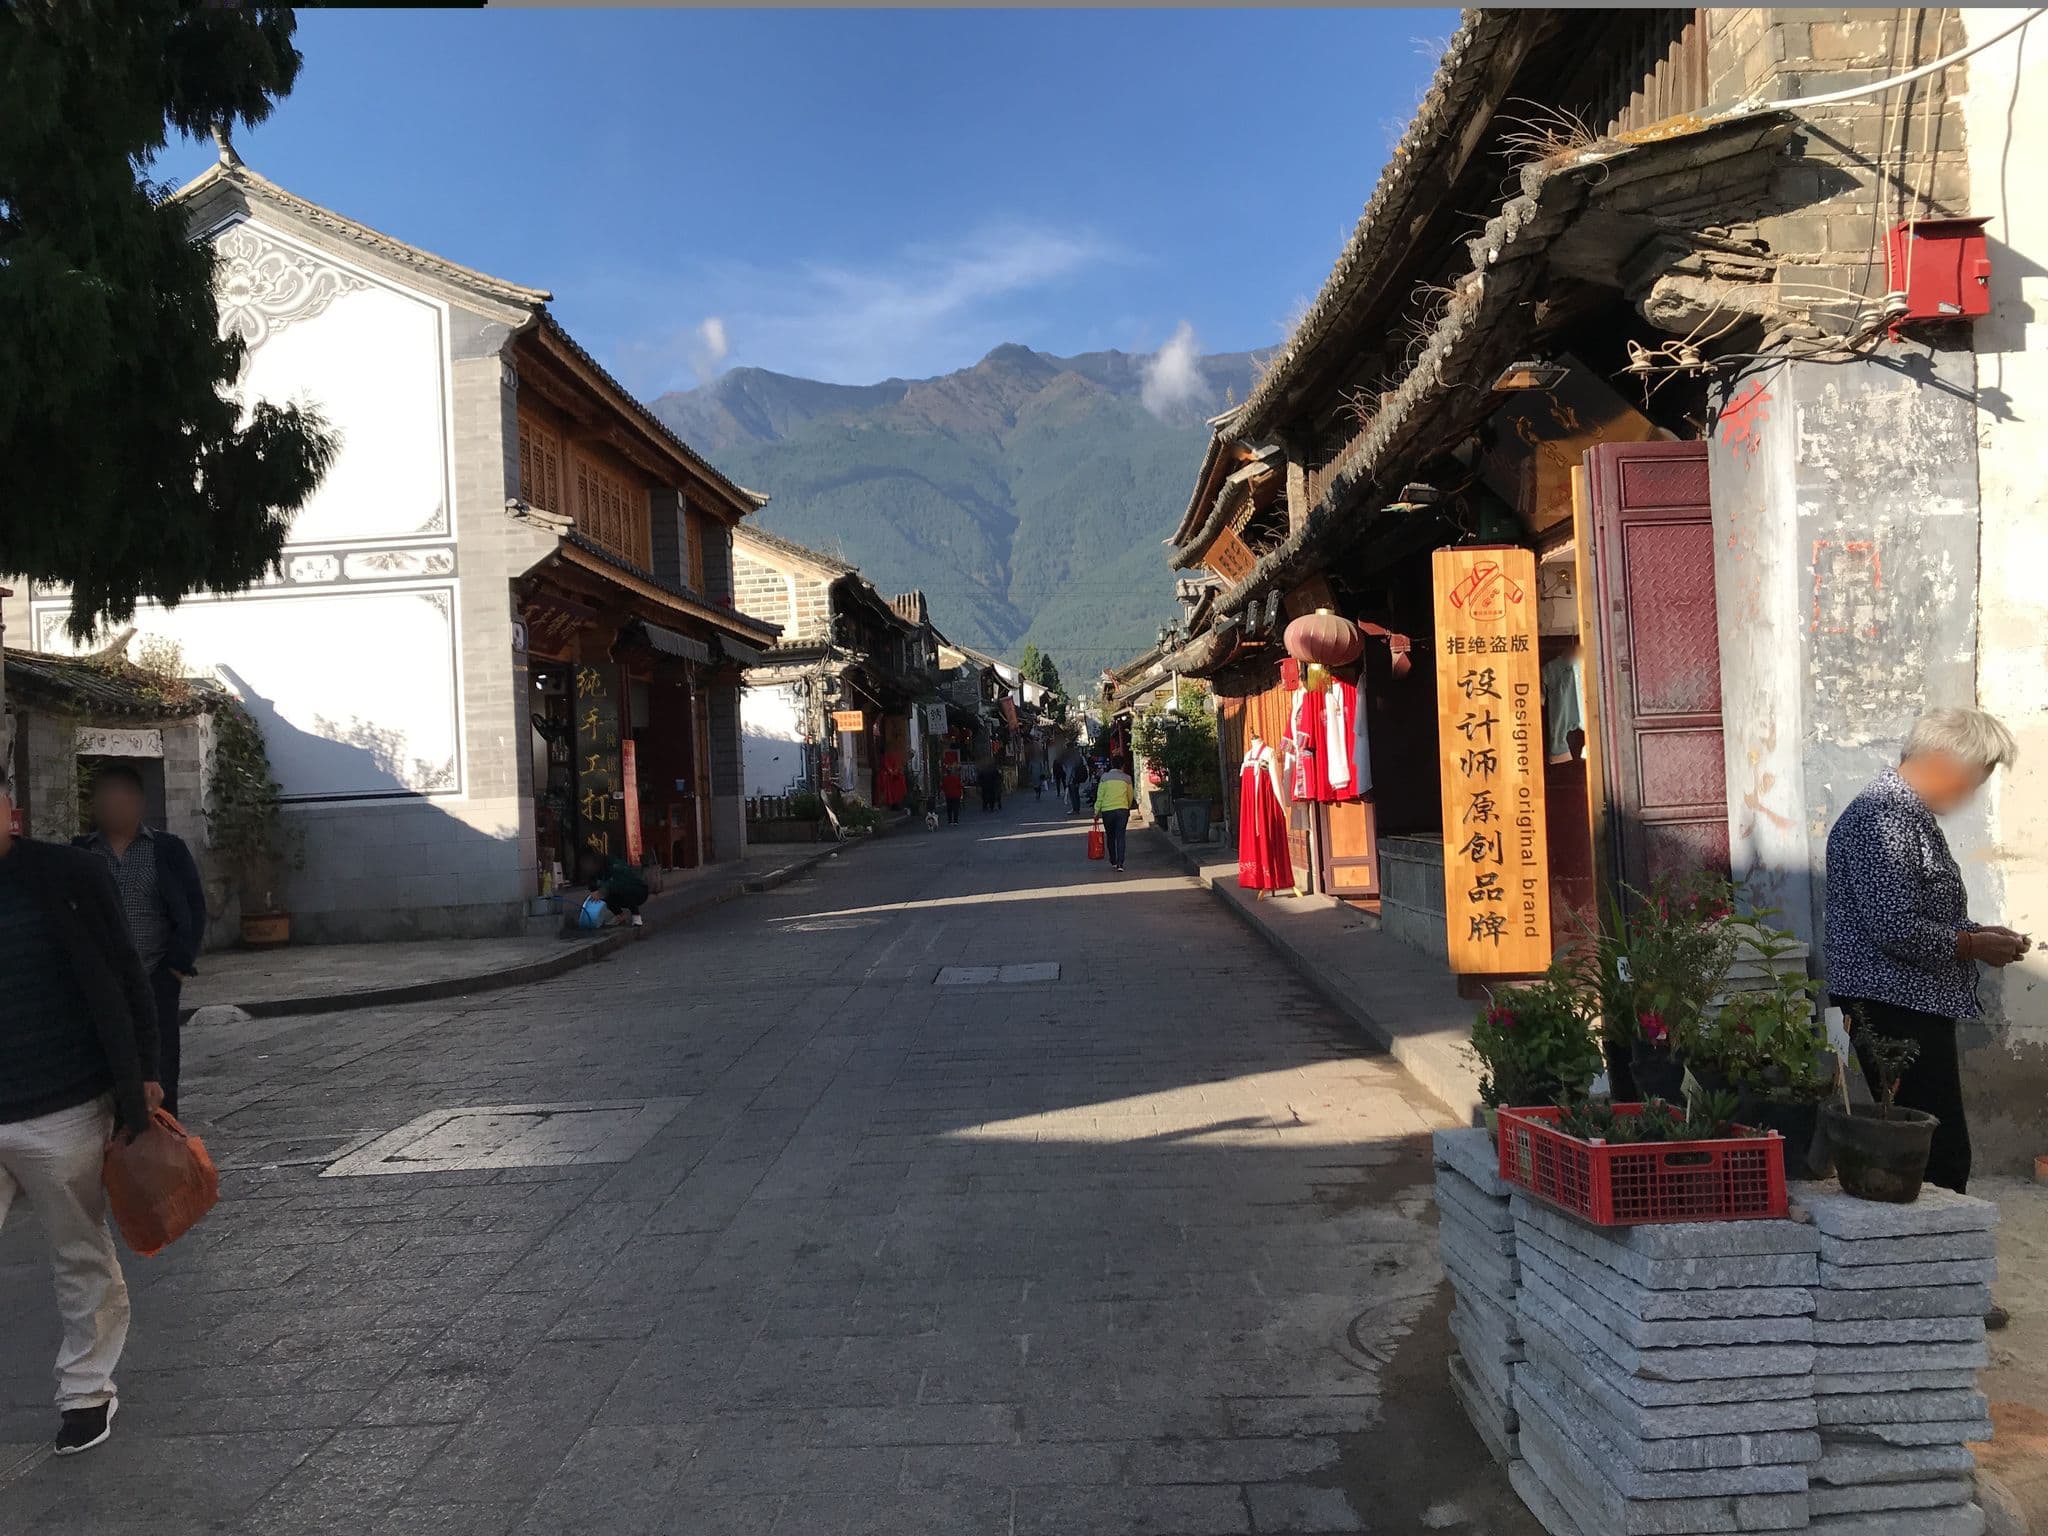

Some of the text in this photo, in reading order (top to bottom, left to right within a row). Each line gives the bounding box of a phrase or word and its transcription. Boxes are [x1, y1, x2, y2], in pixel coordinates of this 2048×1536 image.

[1447, 634, 1530, 655] 拒绝盗版
[1456, 667, 1510, 948] 设计师原创品牌
[1512, 683, 1540, 938] Designer original brand
